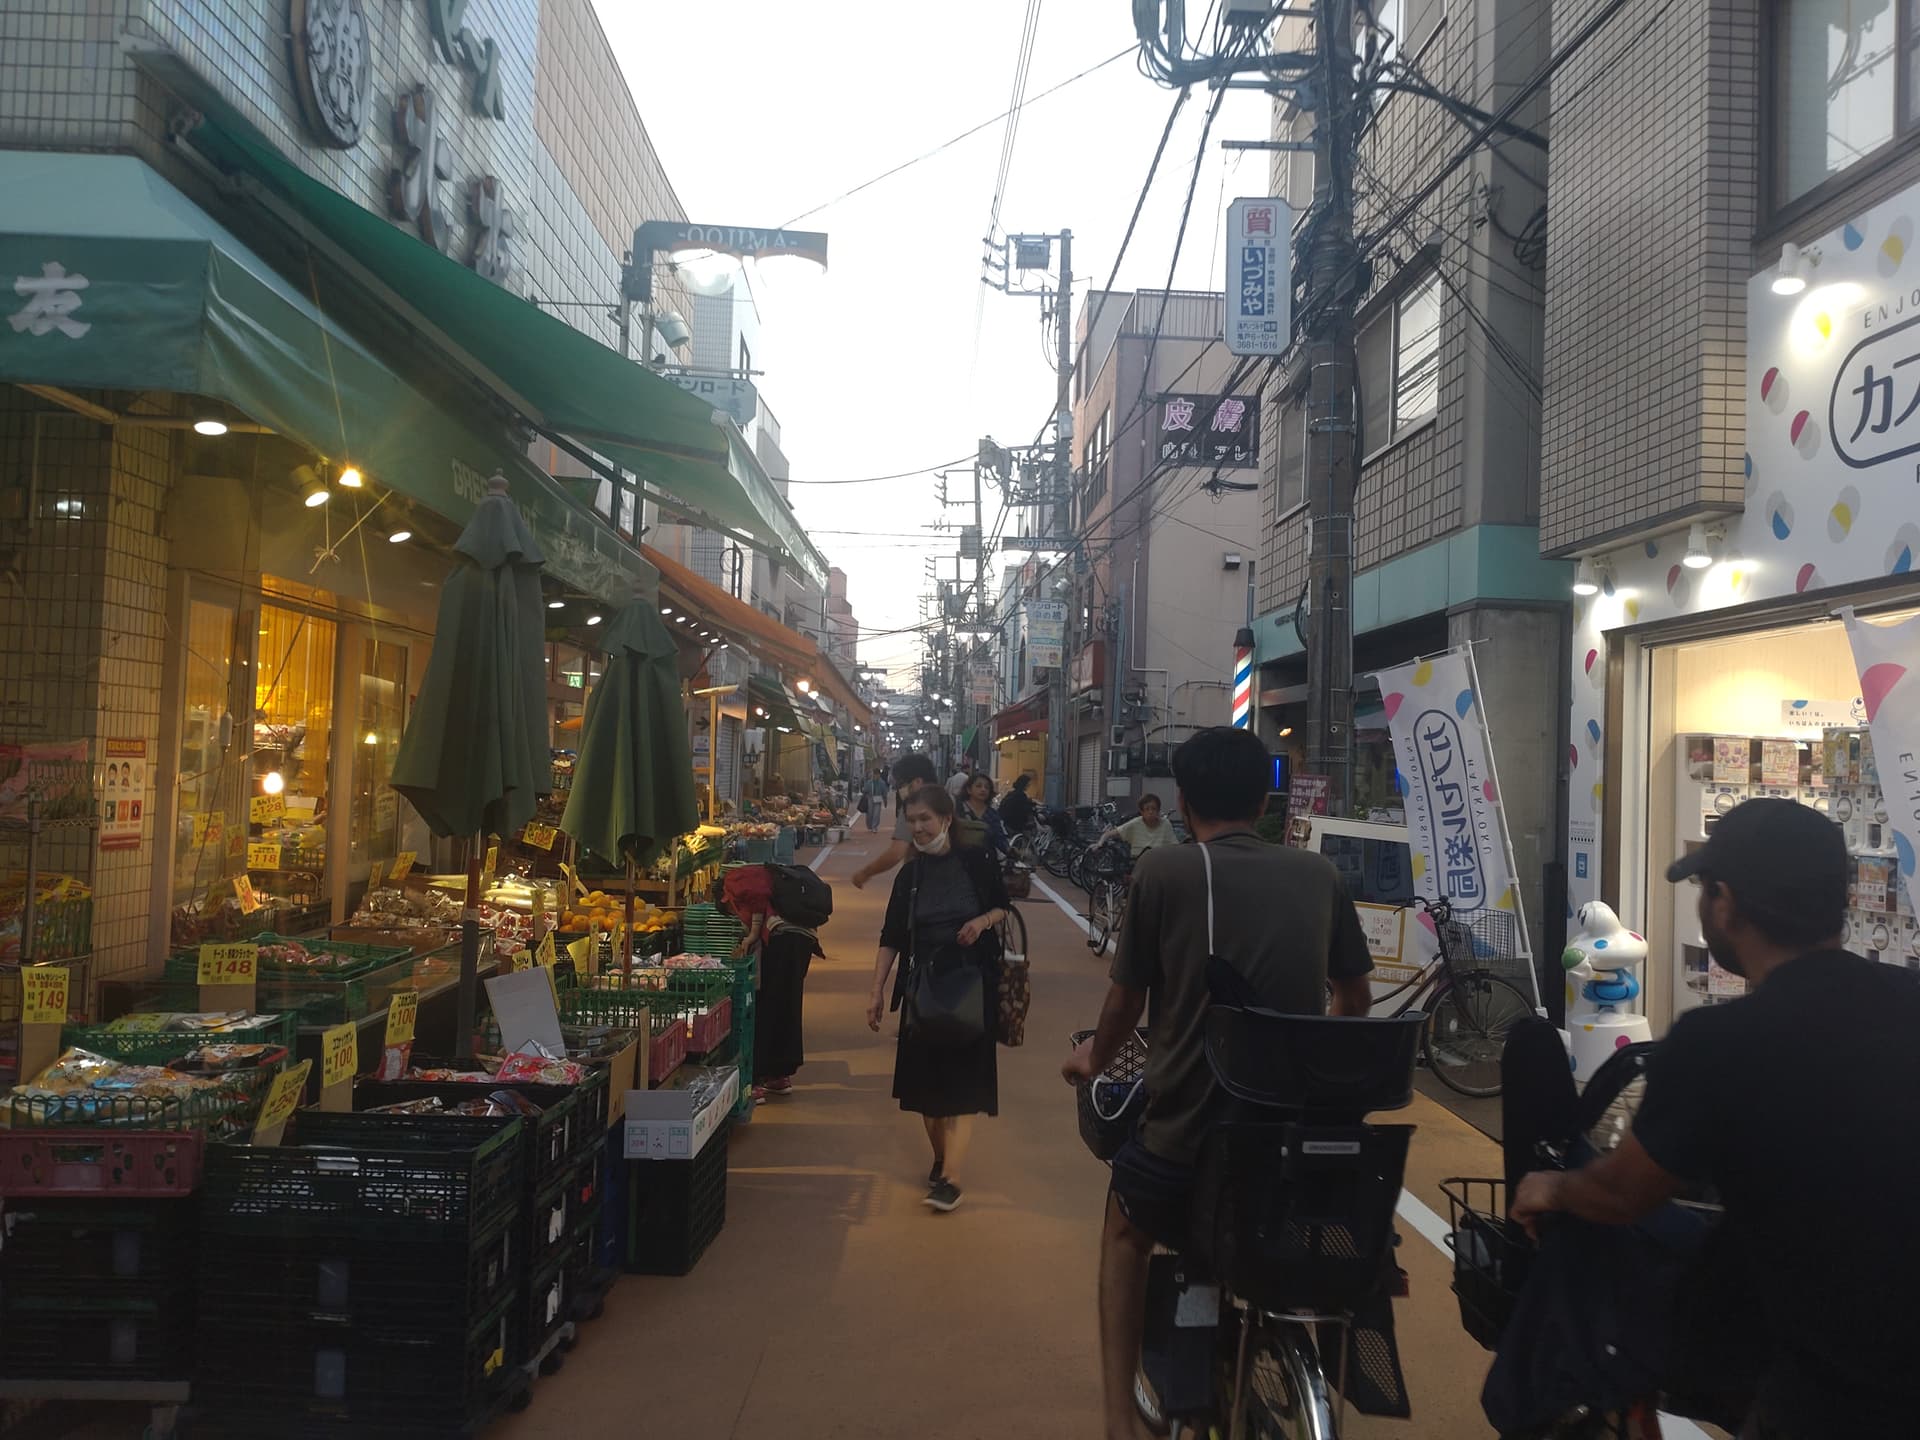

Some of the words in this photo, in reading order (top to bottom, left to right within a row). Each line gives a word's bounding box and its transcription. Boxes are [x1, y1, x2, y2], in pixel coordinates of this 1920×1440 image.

[1246, 207, 1273, 234] 質
[1243, 248, 1265, 315] いづみや
[8, 260, 92, 340] 友
[215, 960, 252, 974] 148
[37, 990, 65, 1009] 149
[333, 1045, 353, 1070] 100
